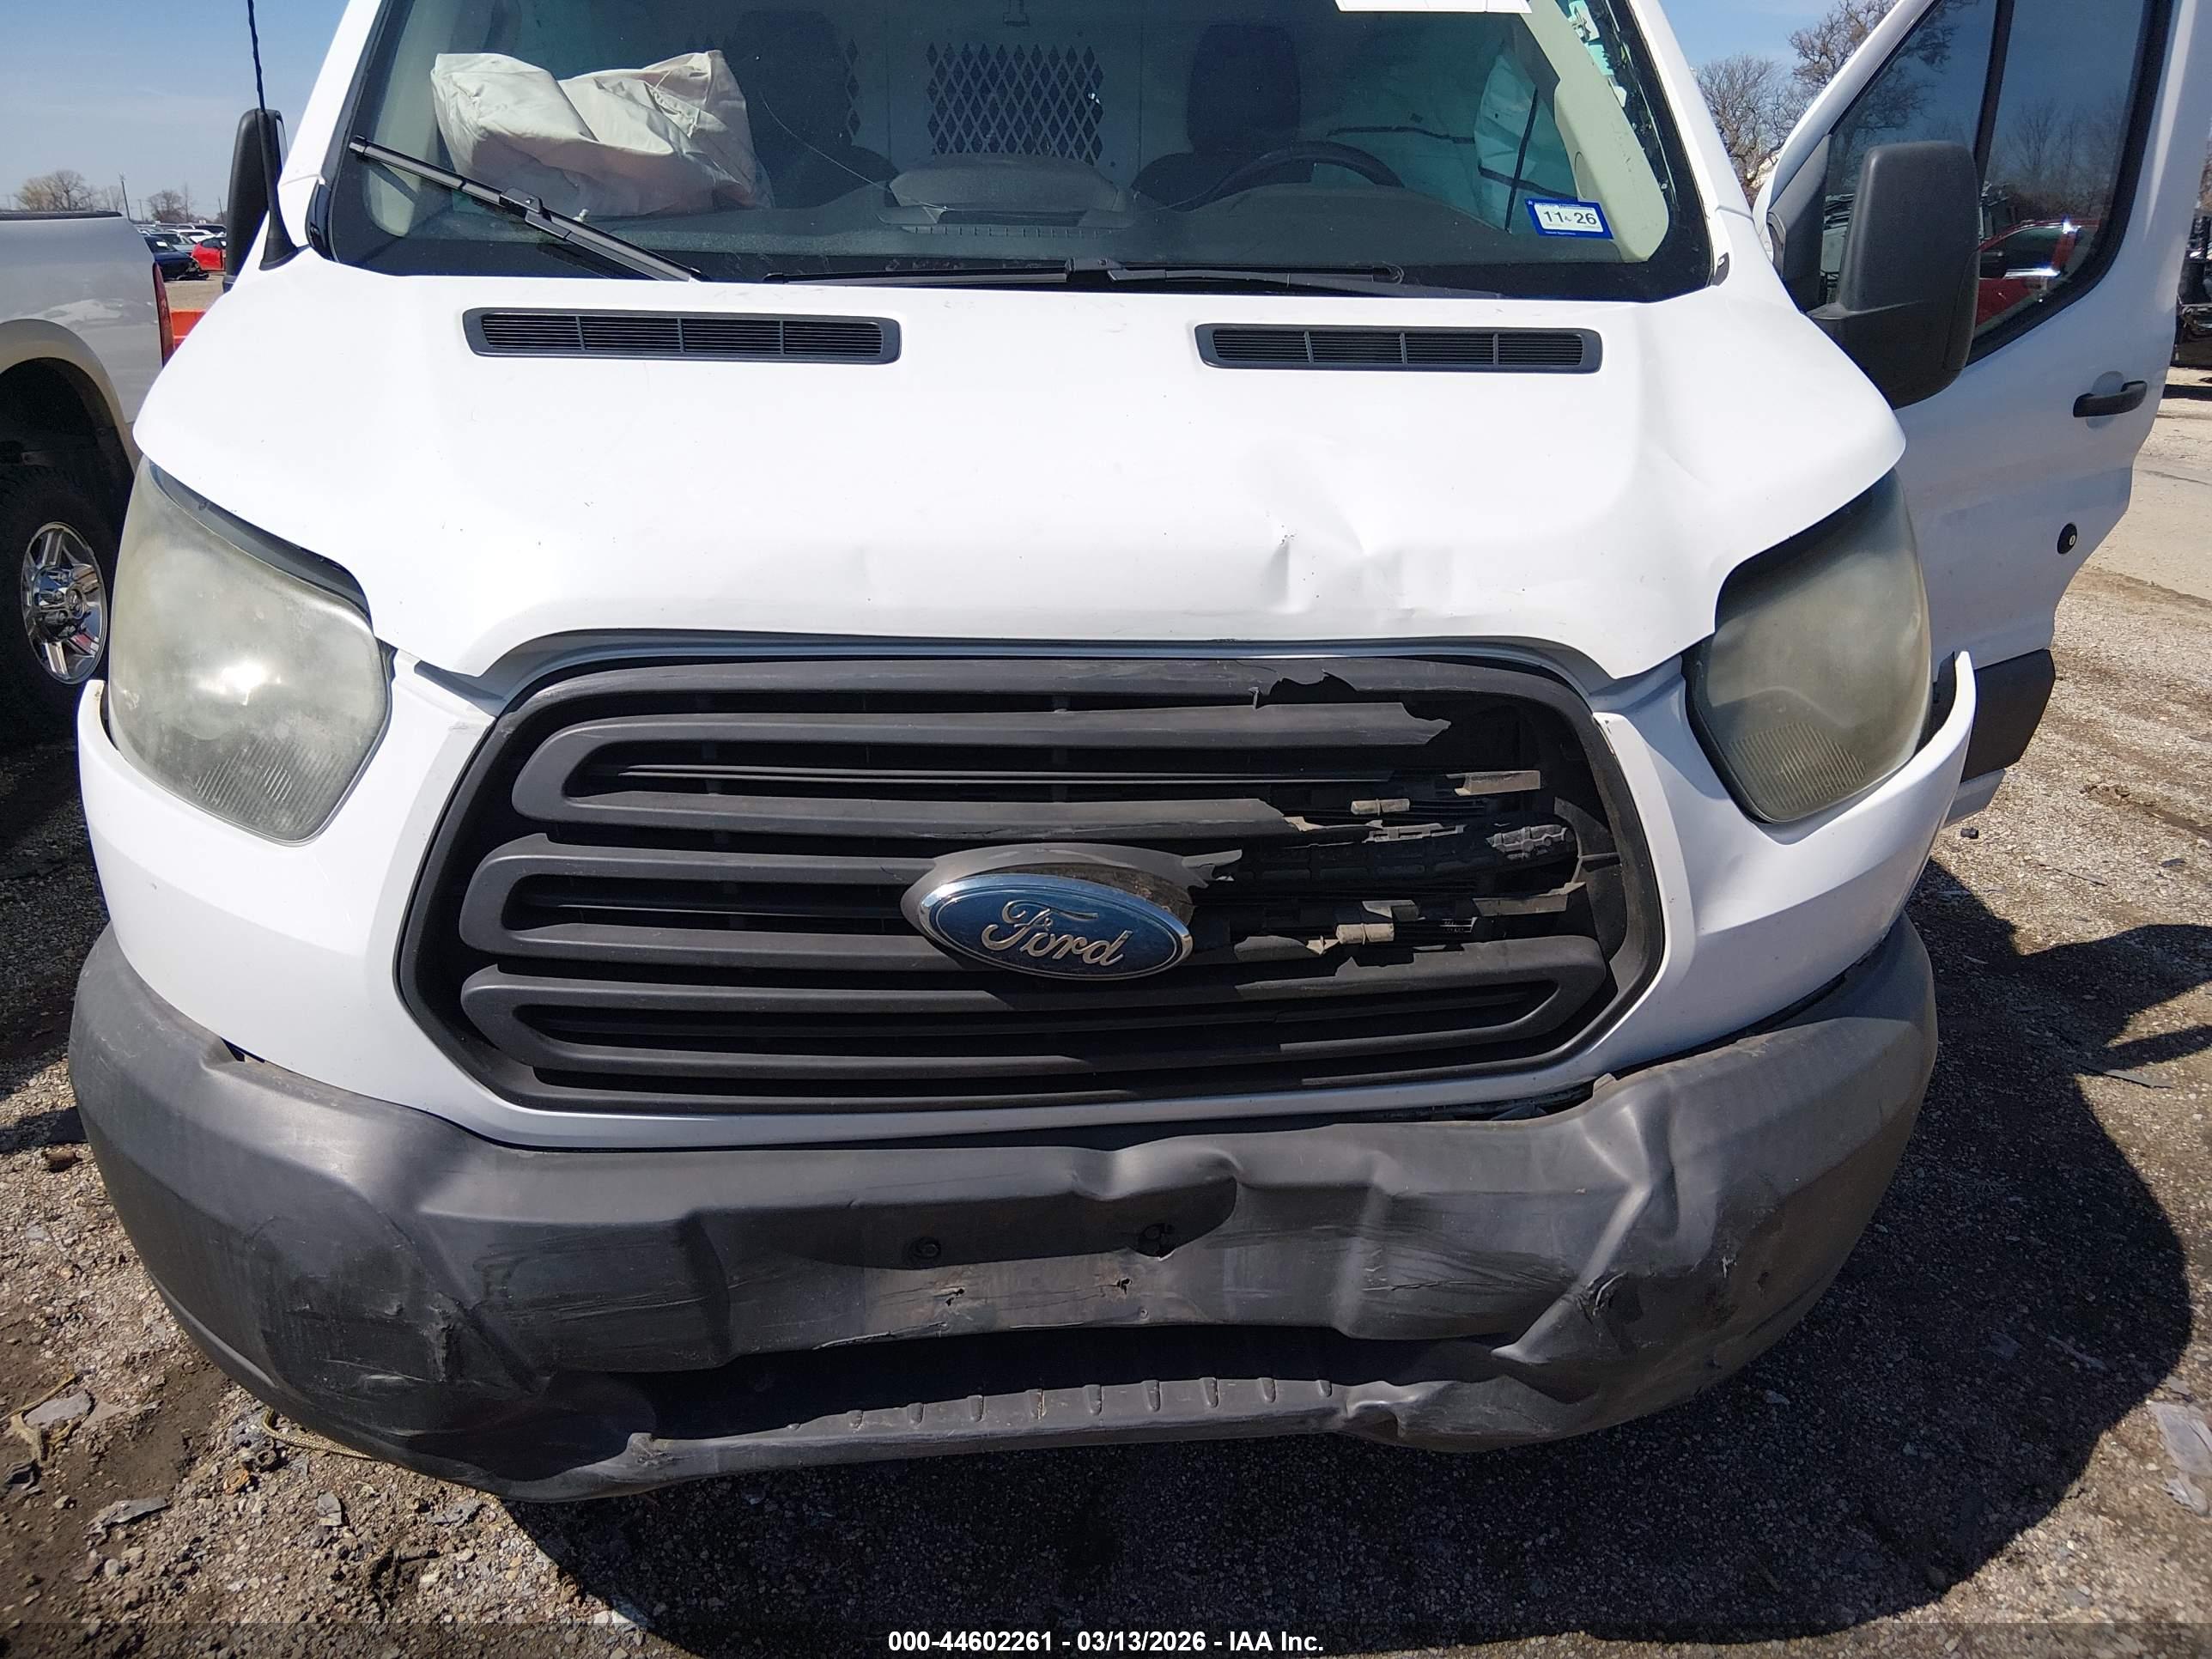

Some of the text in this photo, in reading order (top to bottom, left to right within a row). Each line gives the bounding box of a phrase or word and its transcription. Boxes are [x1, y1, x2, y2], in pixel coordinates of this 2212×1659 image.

[1543, 210, 1597, 225] 11 26
[981, 899, 1133, 967] Ford
